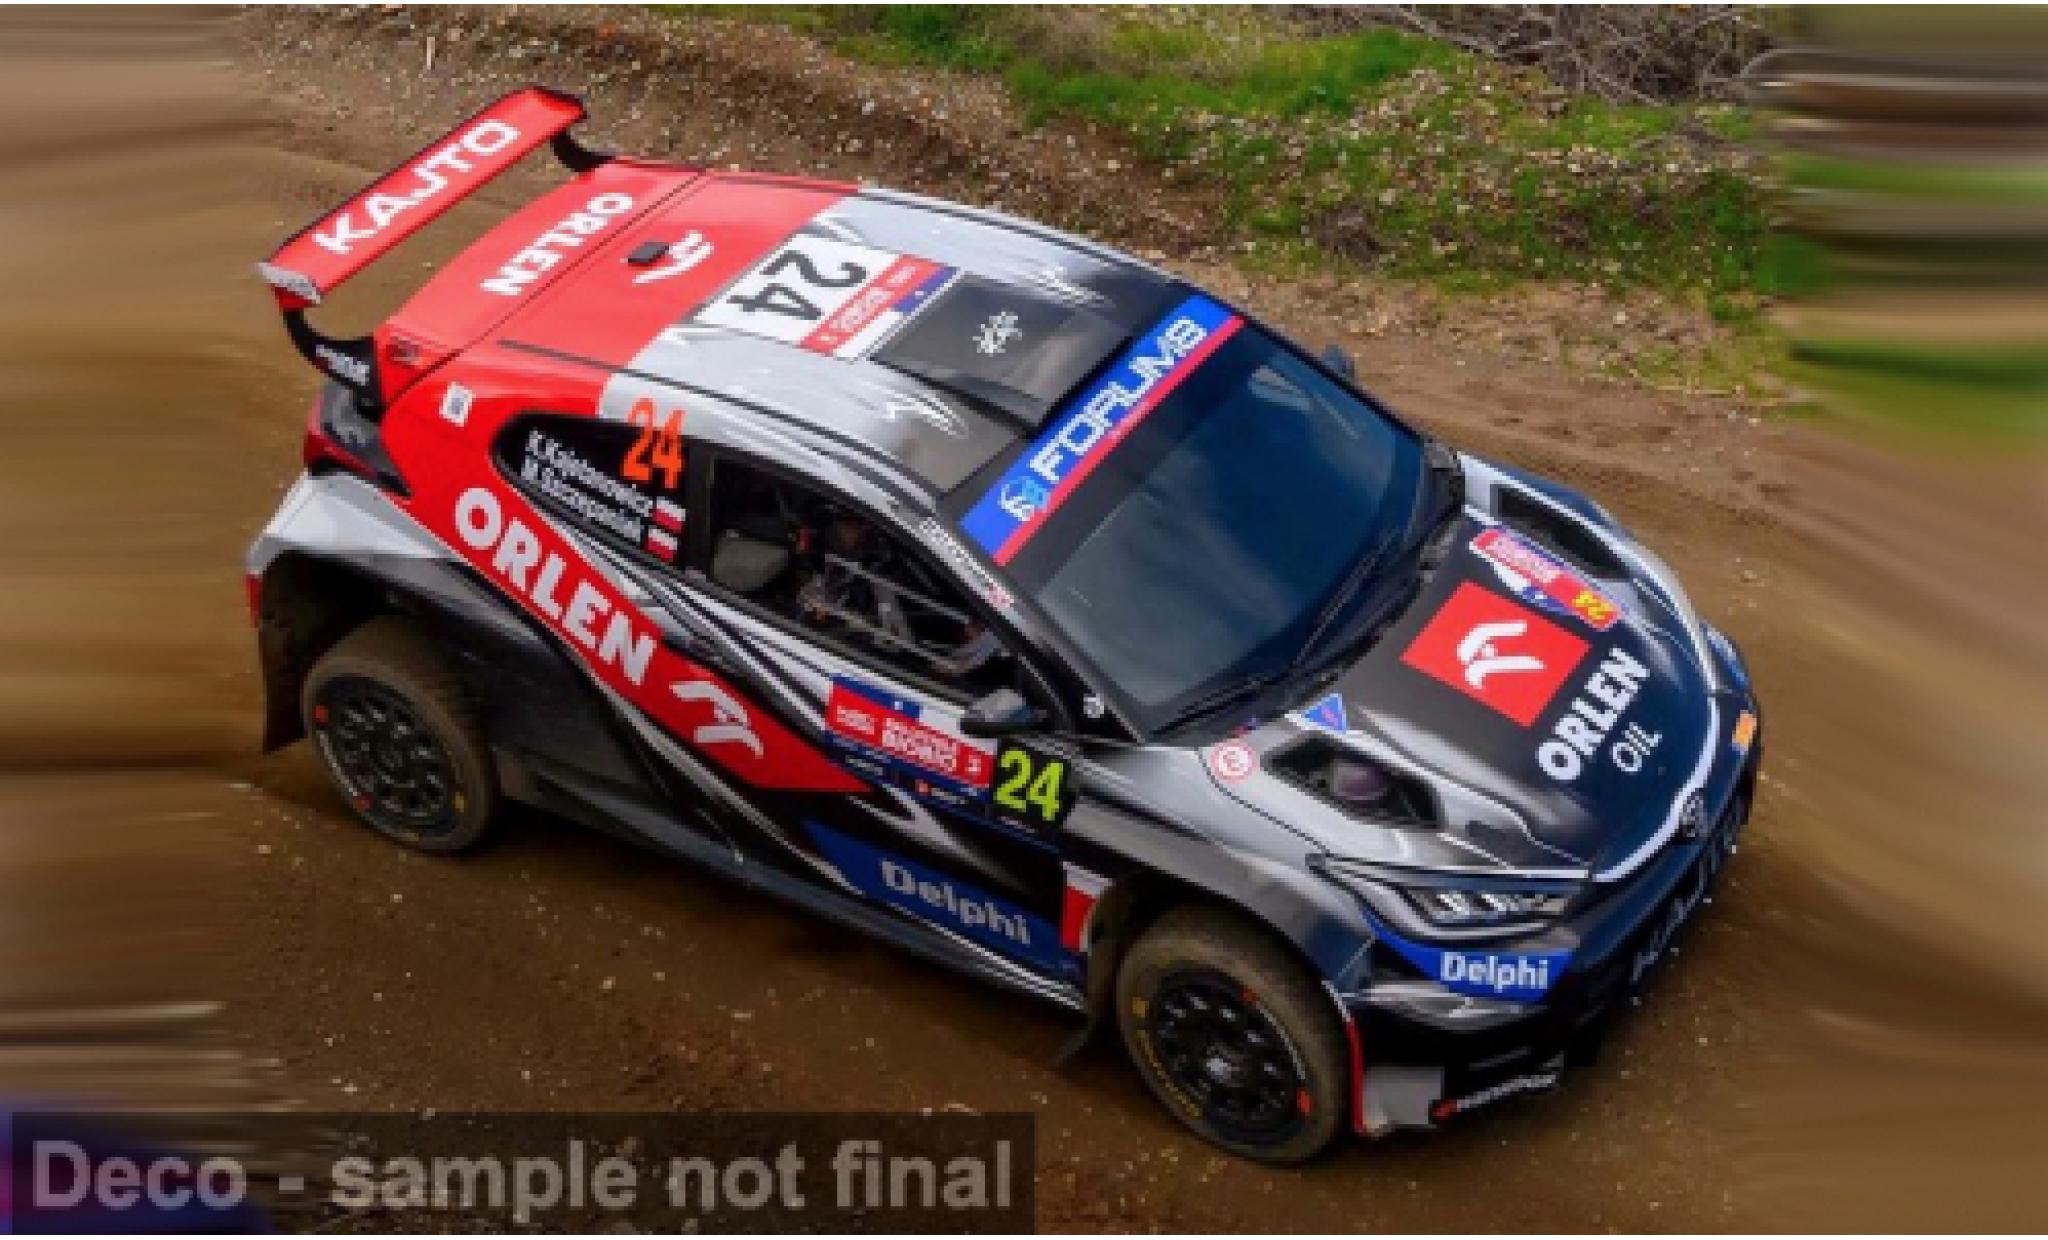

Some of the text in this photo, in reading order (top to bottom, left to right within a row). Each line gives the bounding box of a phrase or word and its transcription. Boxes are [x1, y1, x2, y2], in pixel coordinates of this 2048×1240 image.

[311, 118, 521, 255] KAJTO
[480, 192, 634, 297] ORLEN
[726, 249, 867, 321] 24
[620, 397, 687, 490] 24
[1029, 317, 1208, 484] FORUM8
[455, 487, 657, 686] ORLEN
[1536, 647, 1651, 782] ORLEN
[1612, 722, 1663, 774] OIL
[993, 749, 1064, 822] 24
[881, 860, 1031, 946] Delphi
[1440, 951, 1549, 993] Delphi
